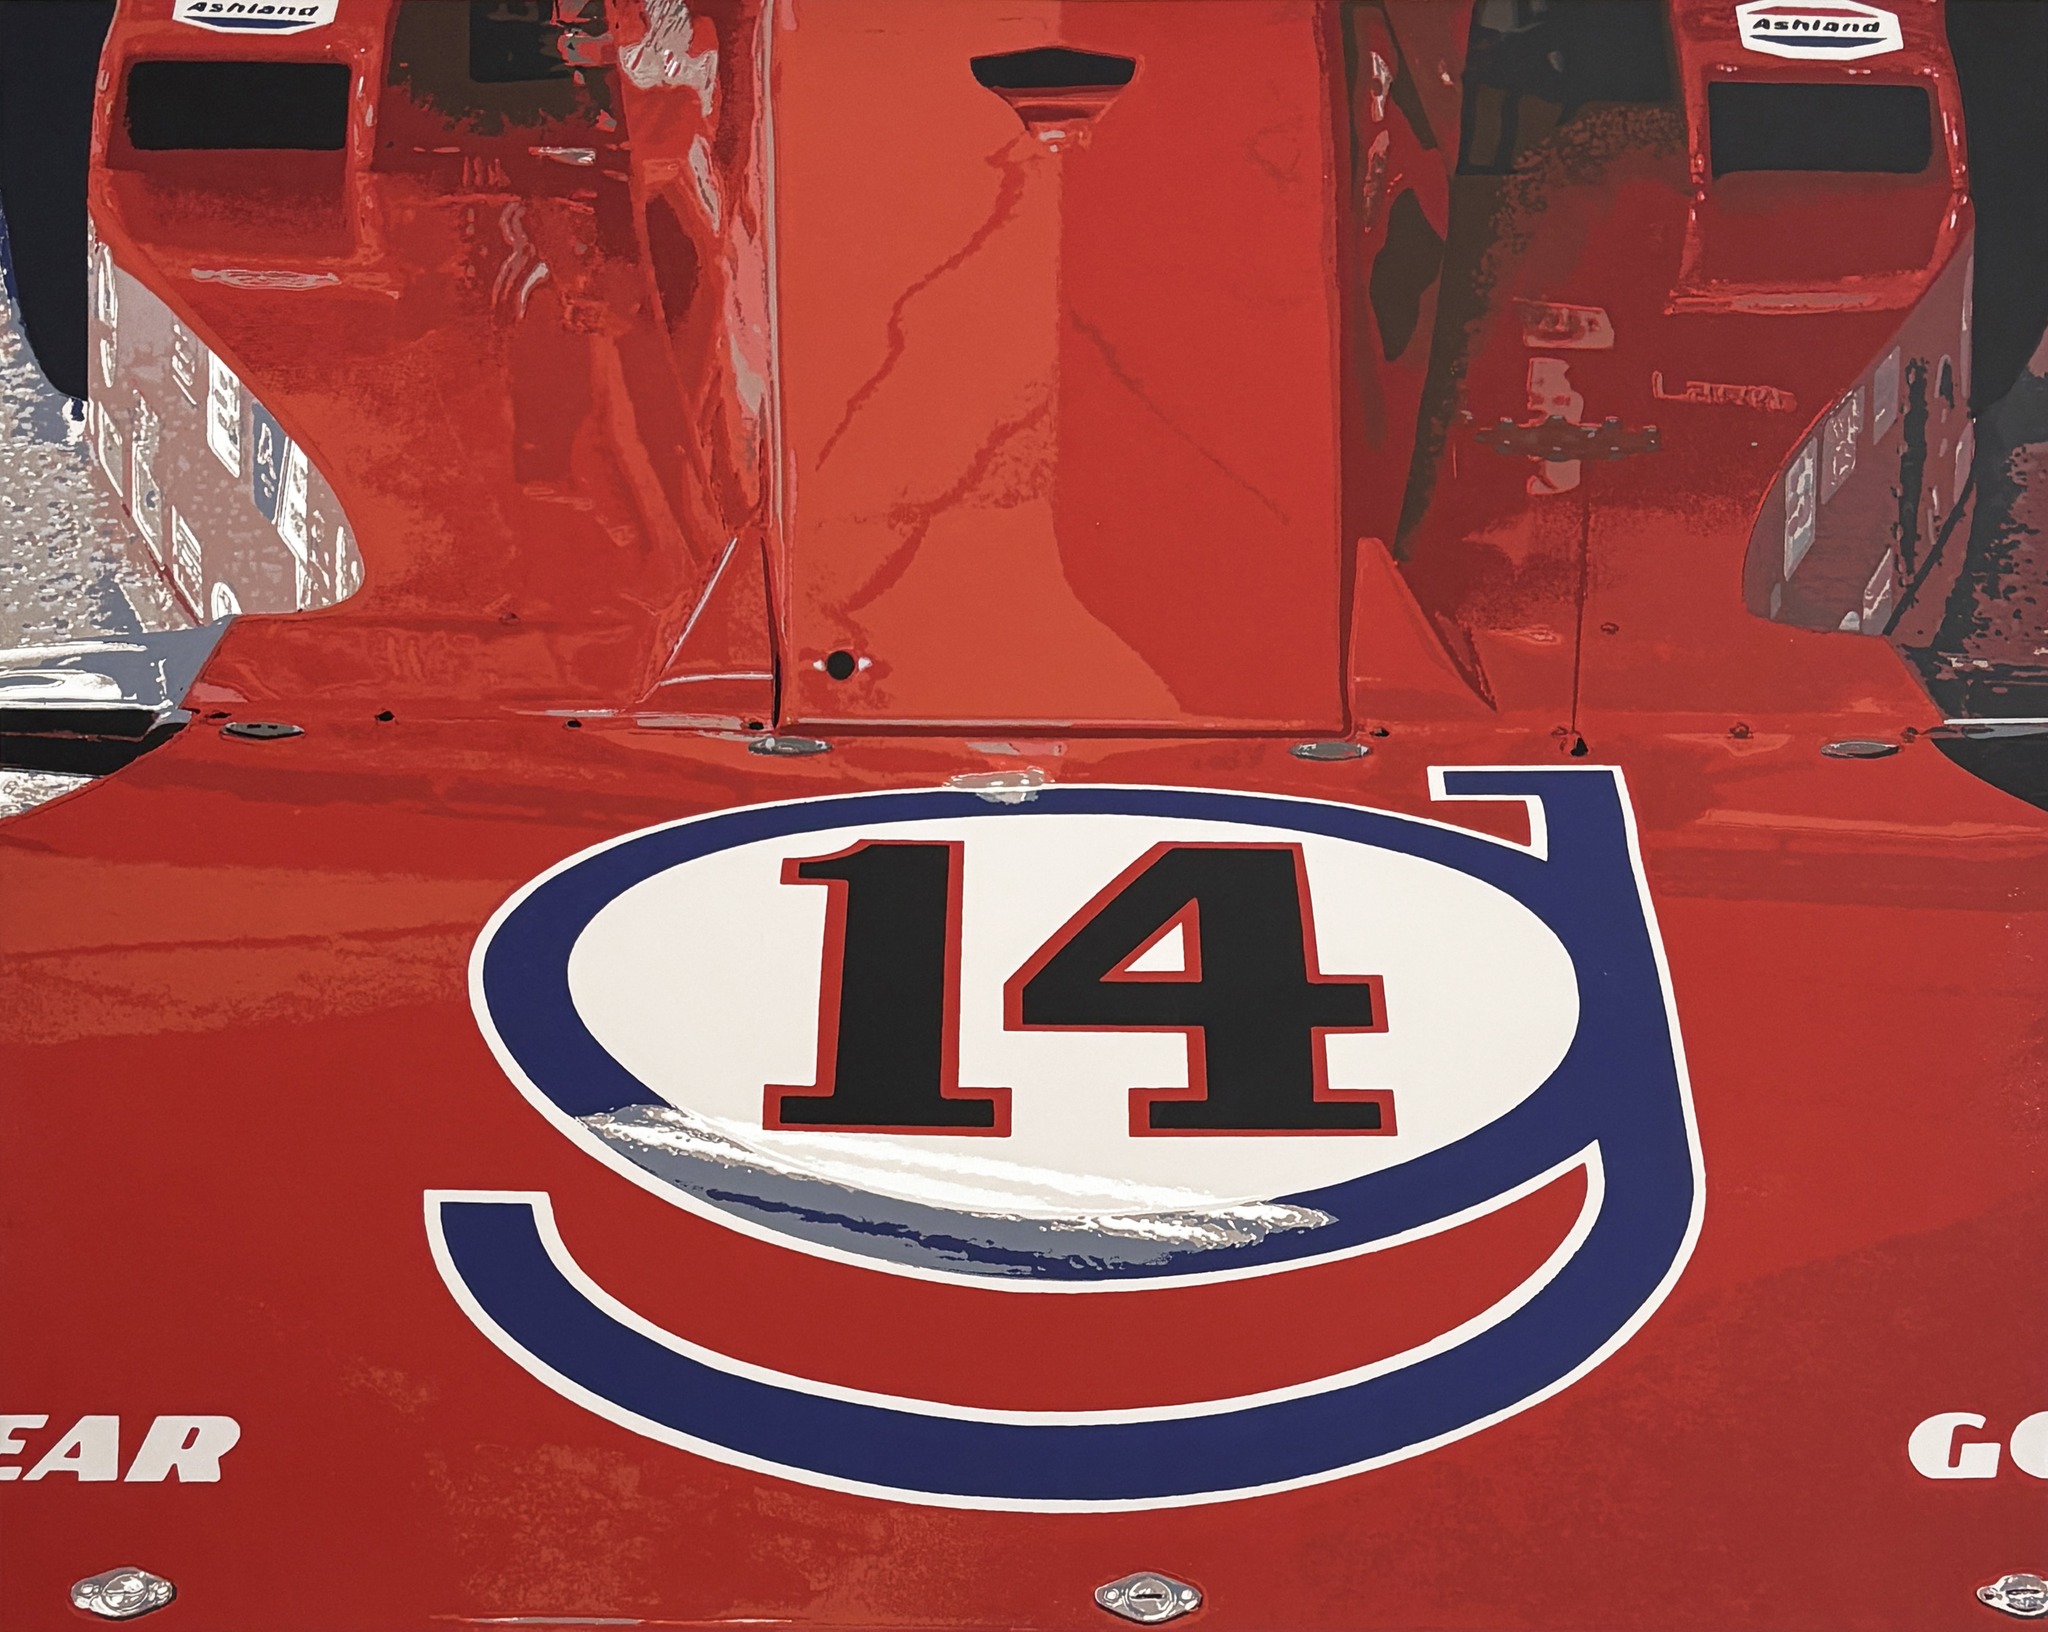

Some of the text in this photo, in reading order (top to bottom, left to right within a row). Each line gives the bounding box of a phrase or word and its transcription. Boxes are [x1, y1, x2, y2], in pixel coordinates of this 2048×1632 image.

[186, 2, 319, 16] Ashland
[1752, 18, 1881, 33] Ashland
[763, 839, 1398, 1137] 14
